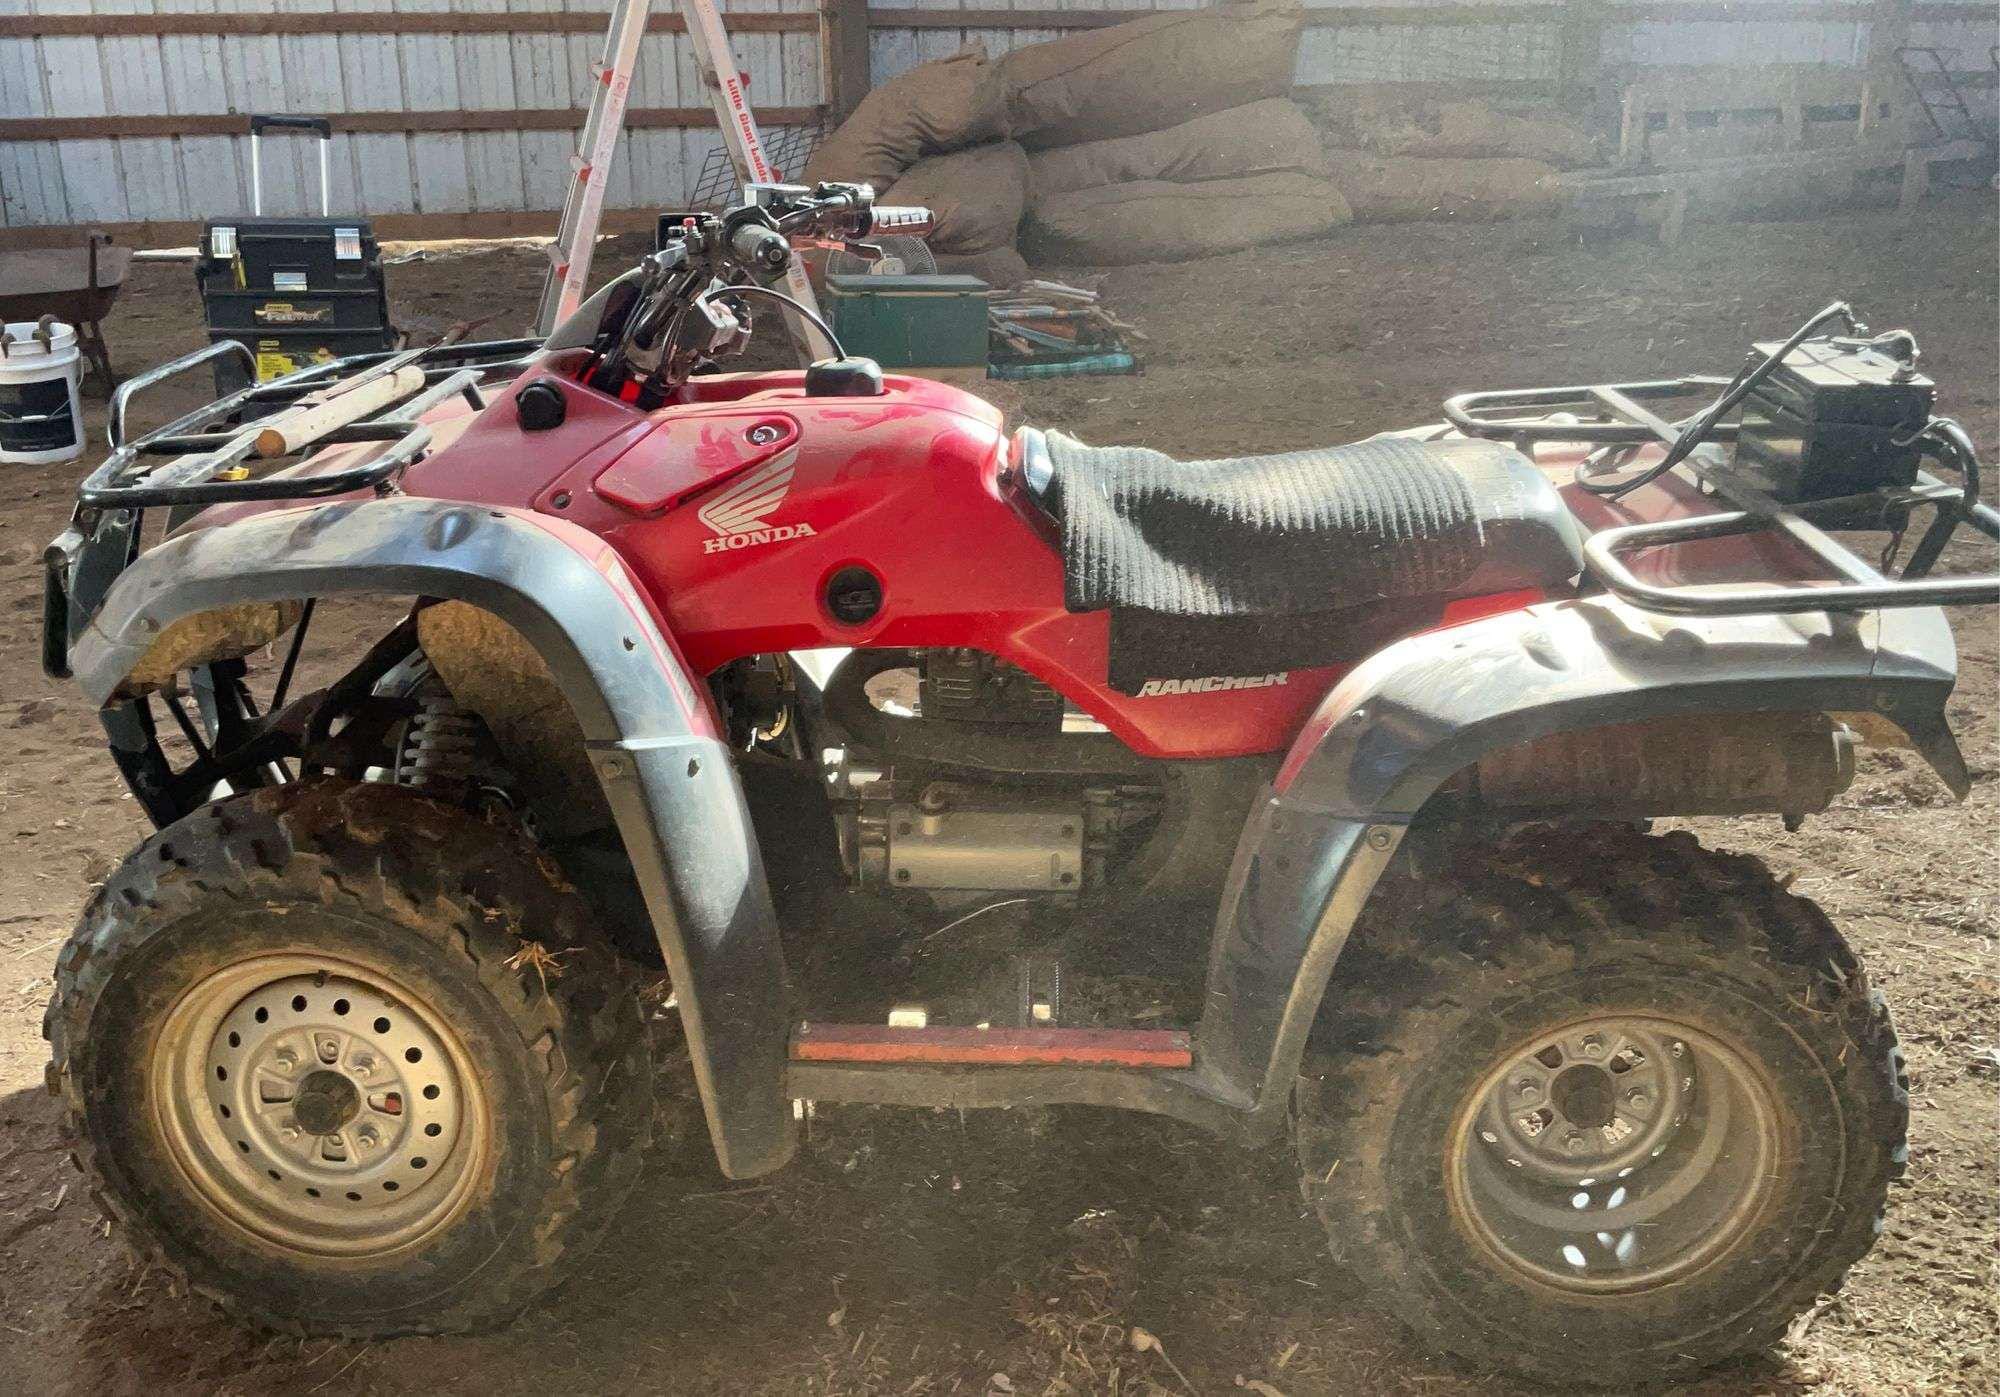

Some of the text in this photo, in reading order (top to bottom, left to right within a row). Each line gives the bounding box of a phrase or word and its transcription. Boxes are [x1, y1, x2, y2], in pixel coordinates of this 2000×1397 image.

[727, 78, 769, 184] Little Giant Ladde
[702, 522, 818, 555] HONDA
[1135, 671, 1289, 698] RANCHER
